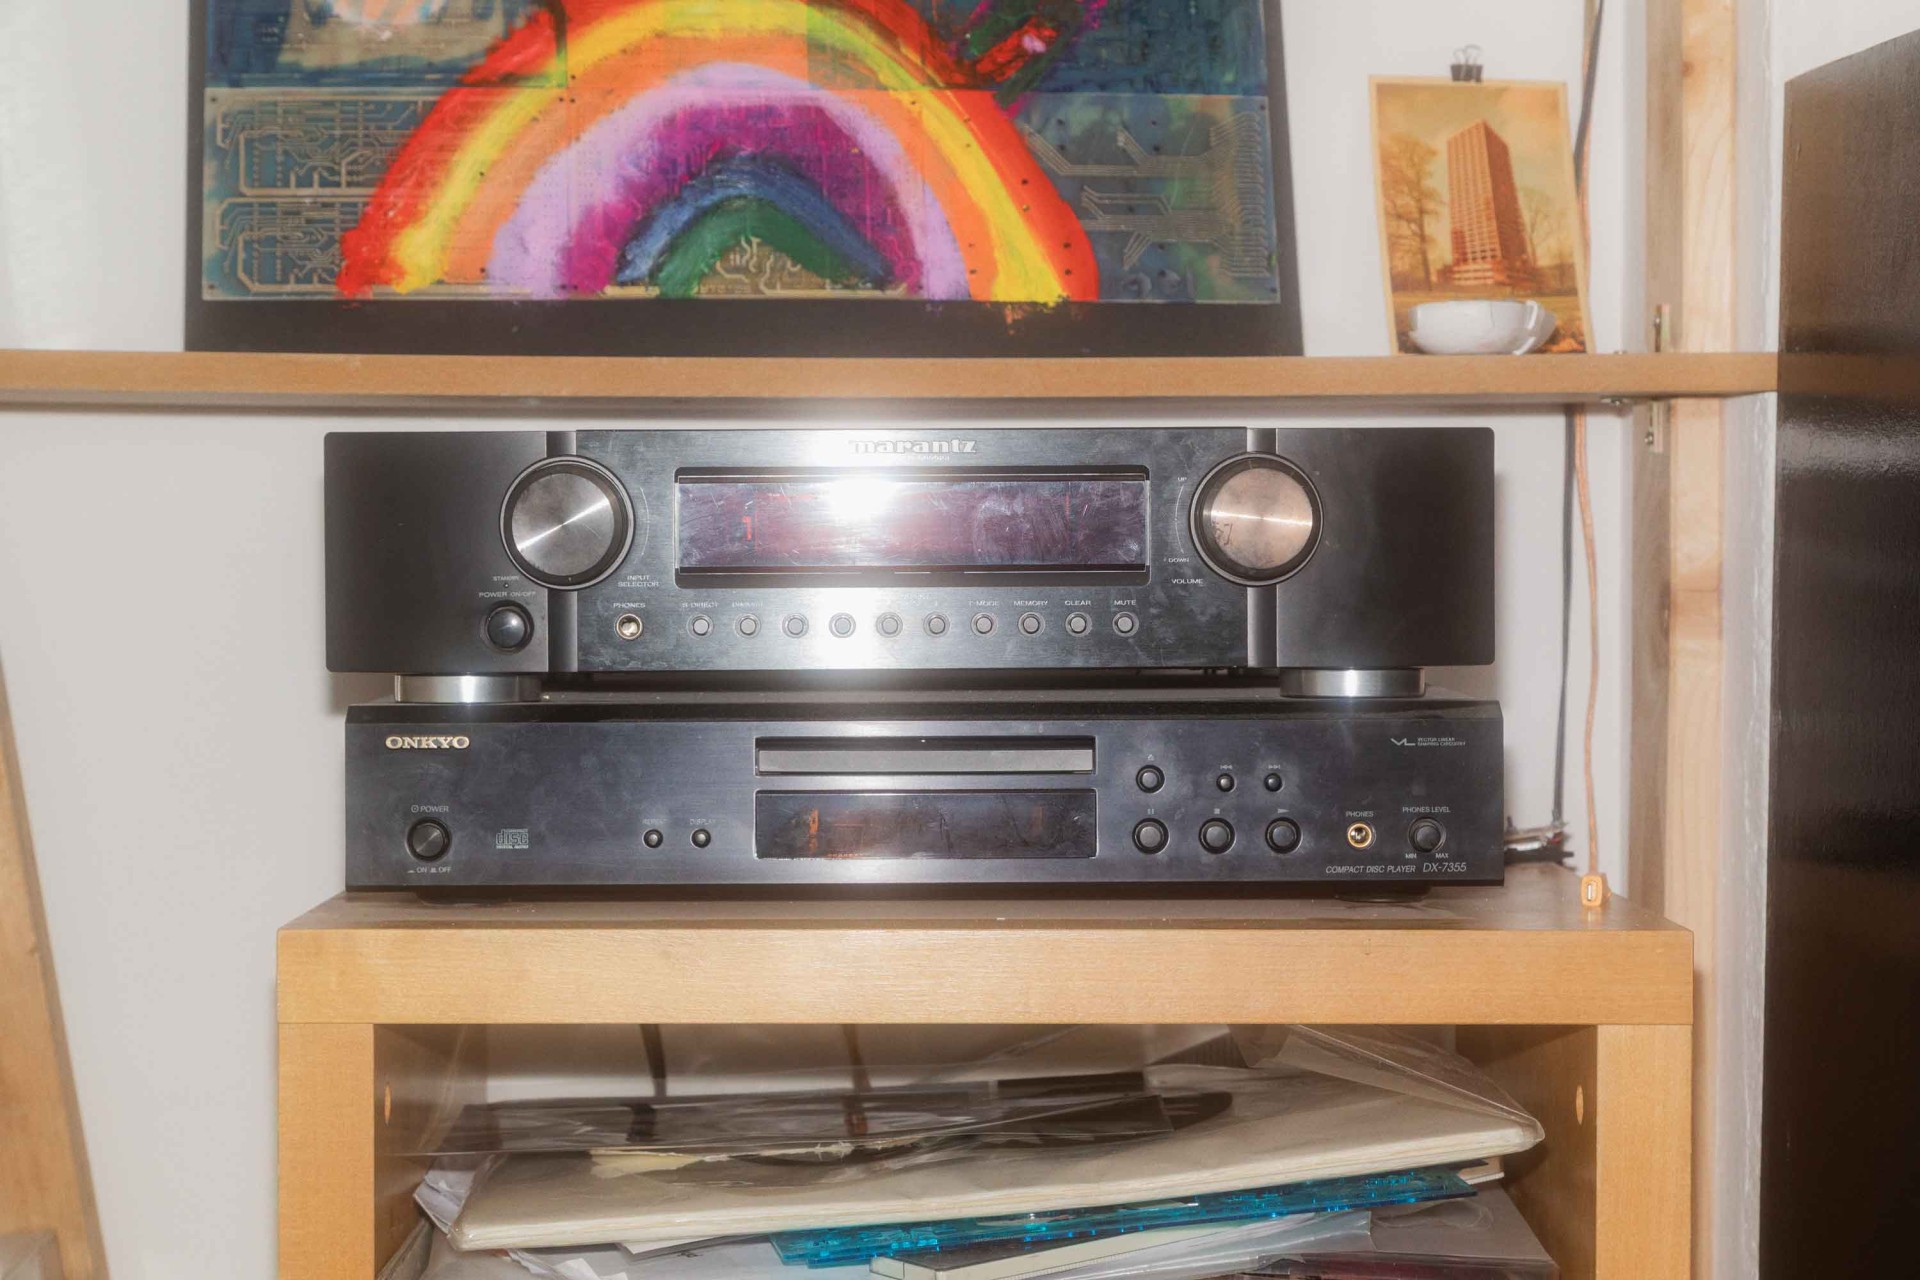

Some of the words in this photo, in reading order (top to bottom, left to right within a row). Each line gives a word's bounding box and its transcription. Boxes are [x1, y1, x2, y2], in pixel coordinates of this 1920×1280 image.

[849, 438, 977, 455] marantz
[385, 736, 470, 750] ONKYO
[420, 805, 449, 813] POWER
[1345, 810, 1374, 818] PHONES
[496, 829, 529, 845] disc
[1325, 865, 1364, 874] COMPACT
[1366, 865, 1386, 873] DISC
[1386, 864, 1416, 873] PLAYER
[1422, 862, 1467, 873] DX-7355
